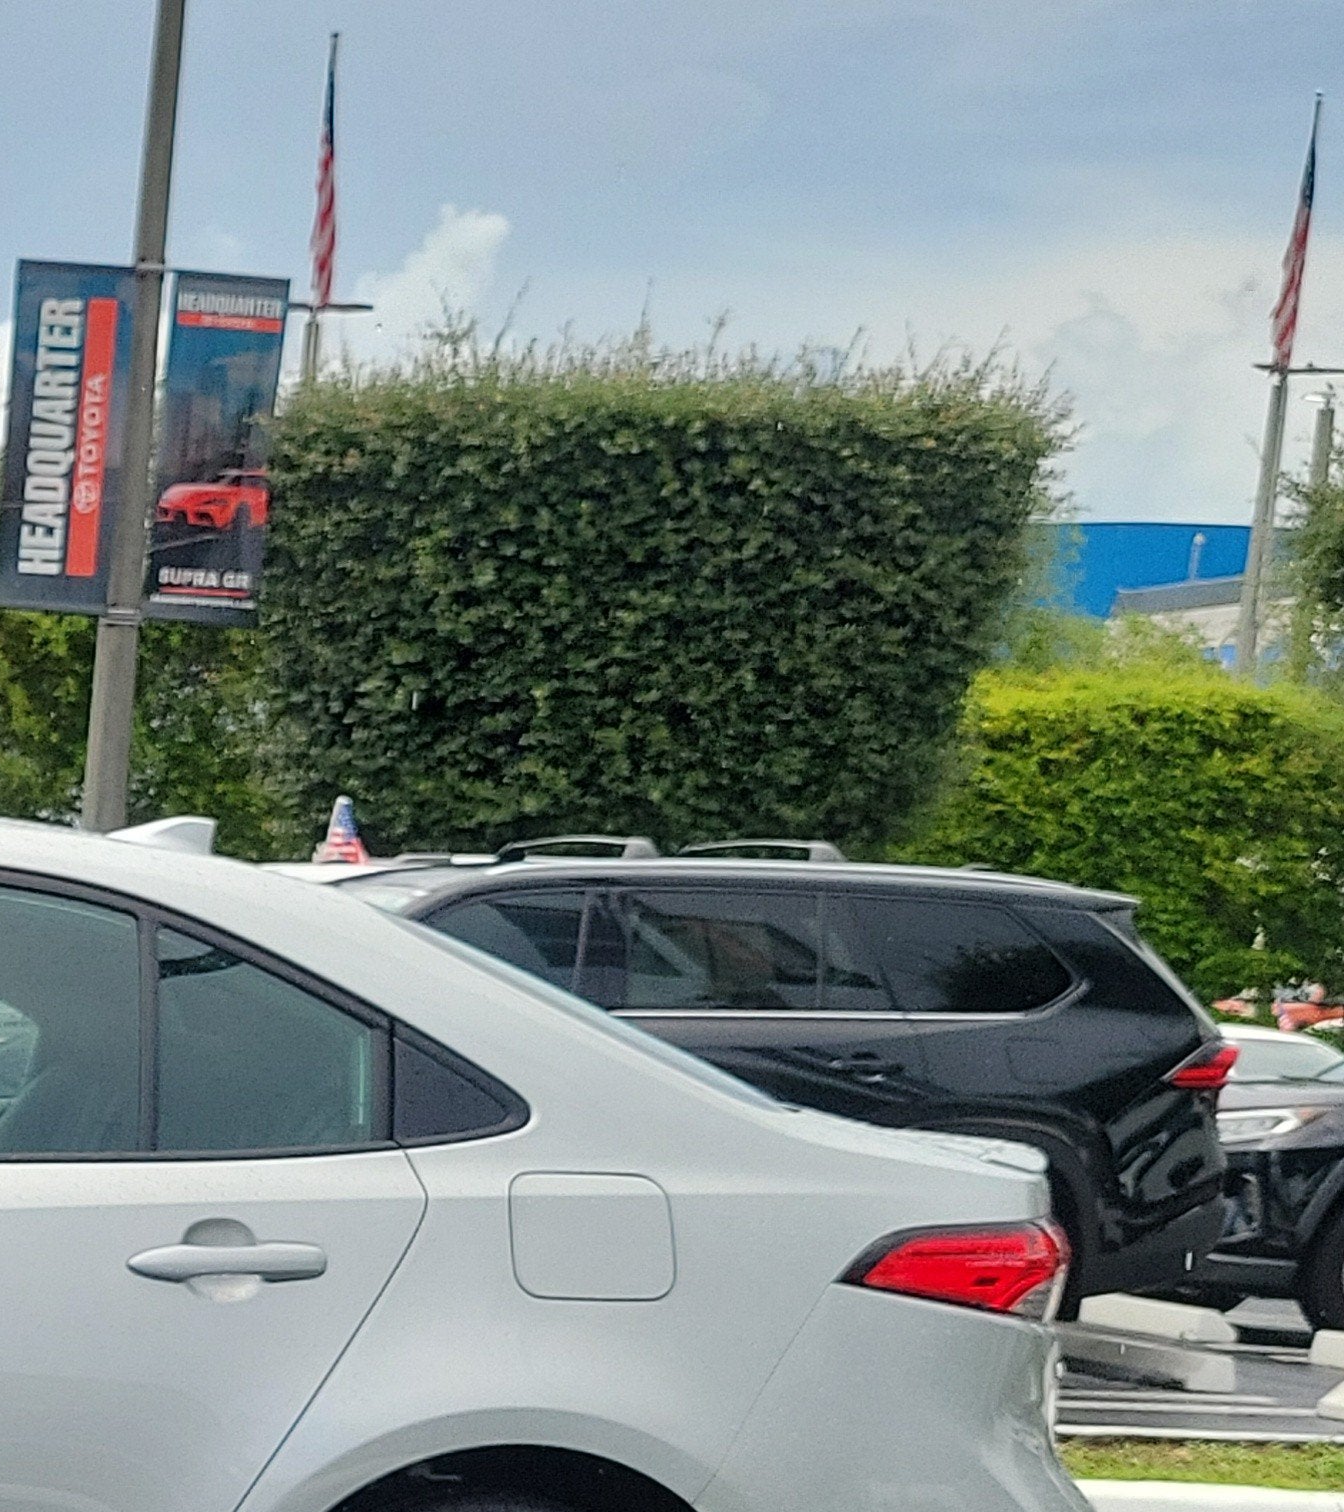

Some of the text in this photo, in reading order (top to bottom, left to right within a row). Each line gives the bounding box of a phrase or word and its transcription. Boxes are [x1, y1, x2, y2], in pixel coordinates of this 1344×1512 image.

[177, 291, 282, 319] HEADQUARTER
[17, 298, 83, 576] HEADQUARTER
[78, 373, 108, 479] TOYOTA
[158, 566, 218, 588] SUPRA
